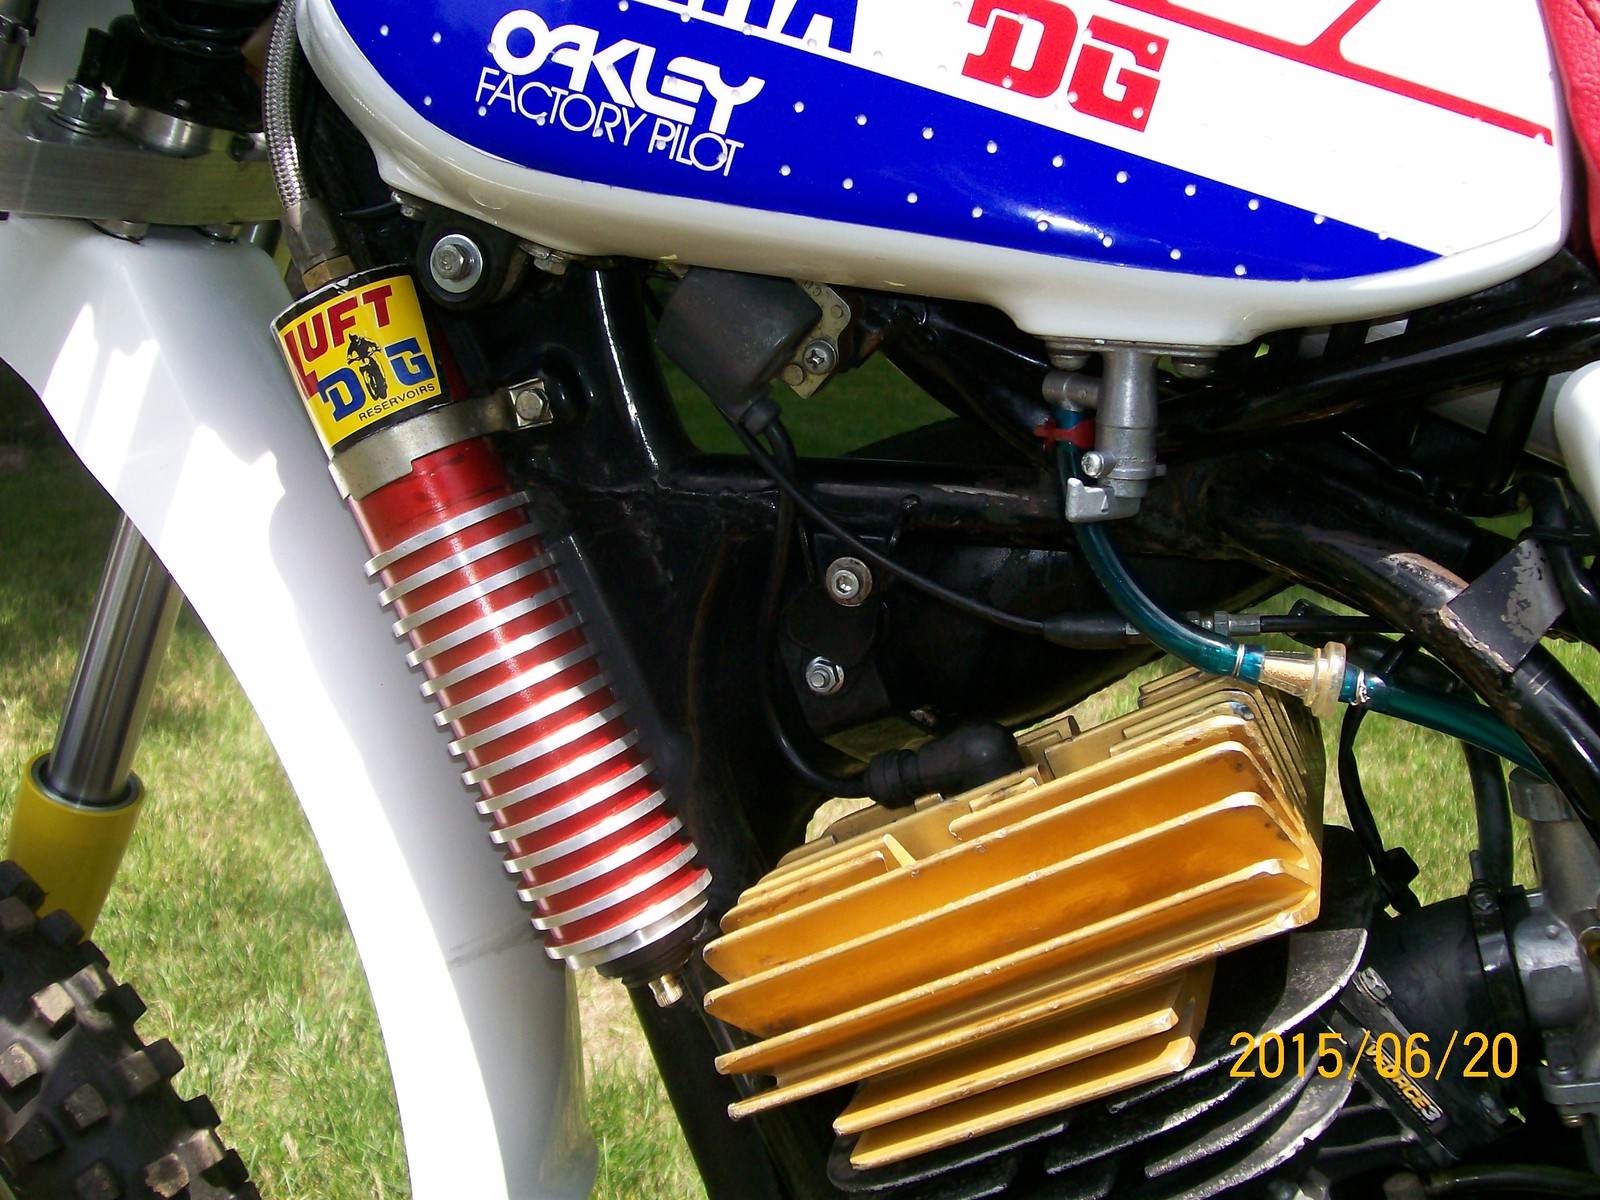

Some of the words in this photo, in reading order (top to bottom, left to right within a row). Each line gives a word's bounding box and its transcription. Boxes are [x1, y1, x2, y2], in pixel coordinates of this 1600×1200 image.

[475, 66, 648, 147] FACTORY
[647, 118, 745, 177] PILOT
[490, 9, 766, 135] OAKLEY
[961, 0, 1170, 133] DG
[358, 383, 436, 422] RESERVOIRS
